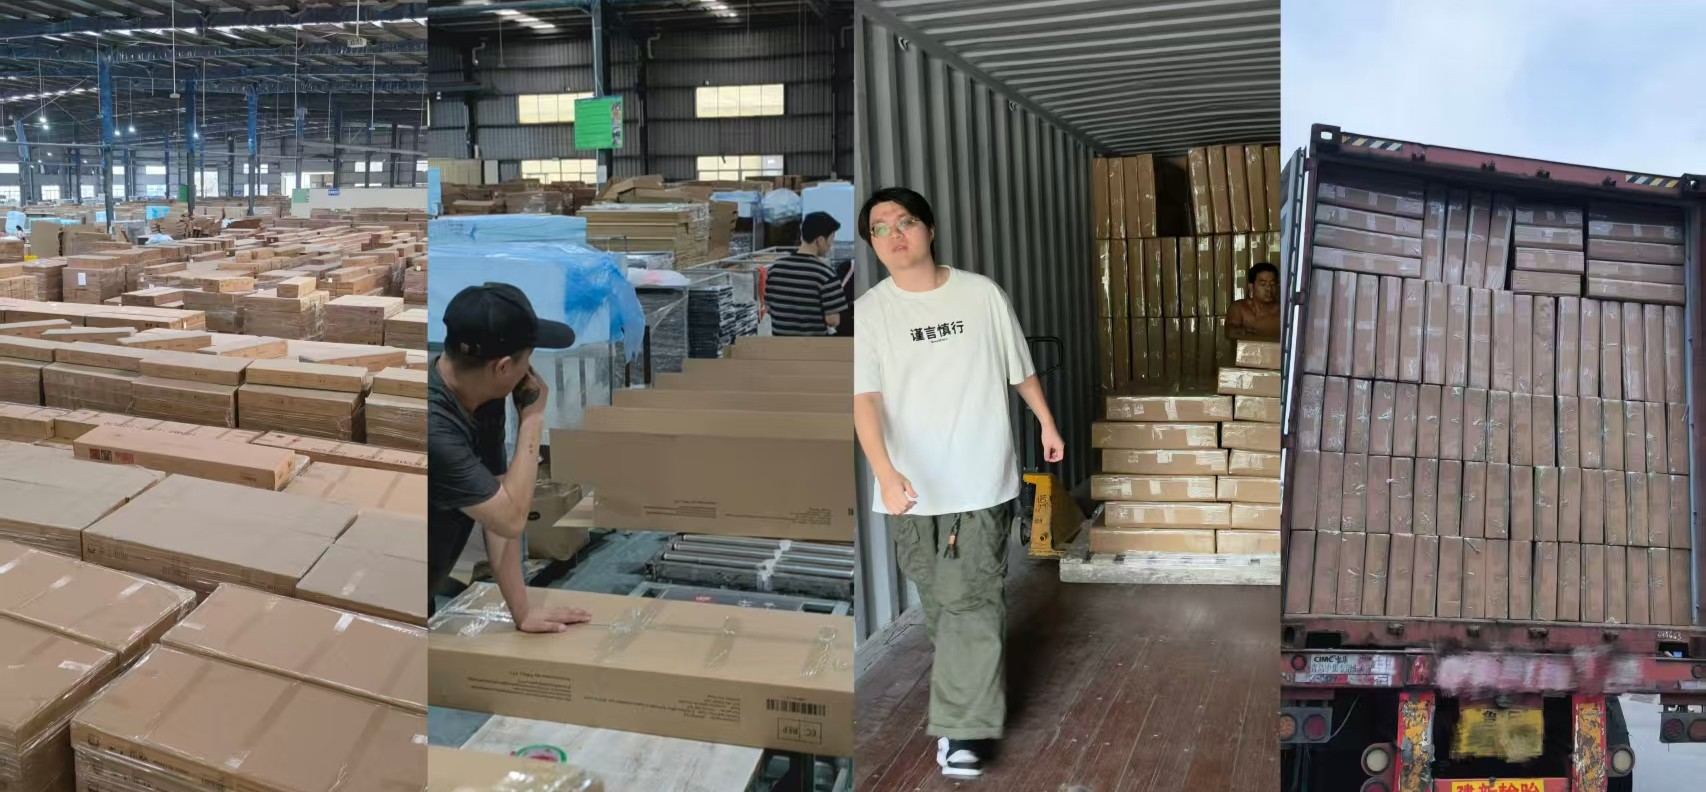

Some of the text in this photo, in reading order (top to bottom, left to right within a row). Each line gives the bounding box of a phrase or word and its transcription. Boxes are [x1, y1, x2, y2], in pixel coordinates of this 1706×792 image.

[910, 320, 964, 341] 谨言慎行
[1313, 655, 1335, 663] CIMC
